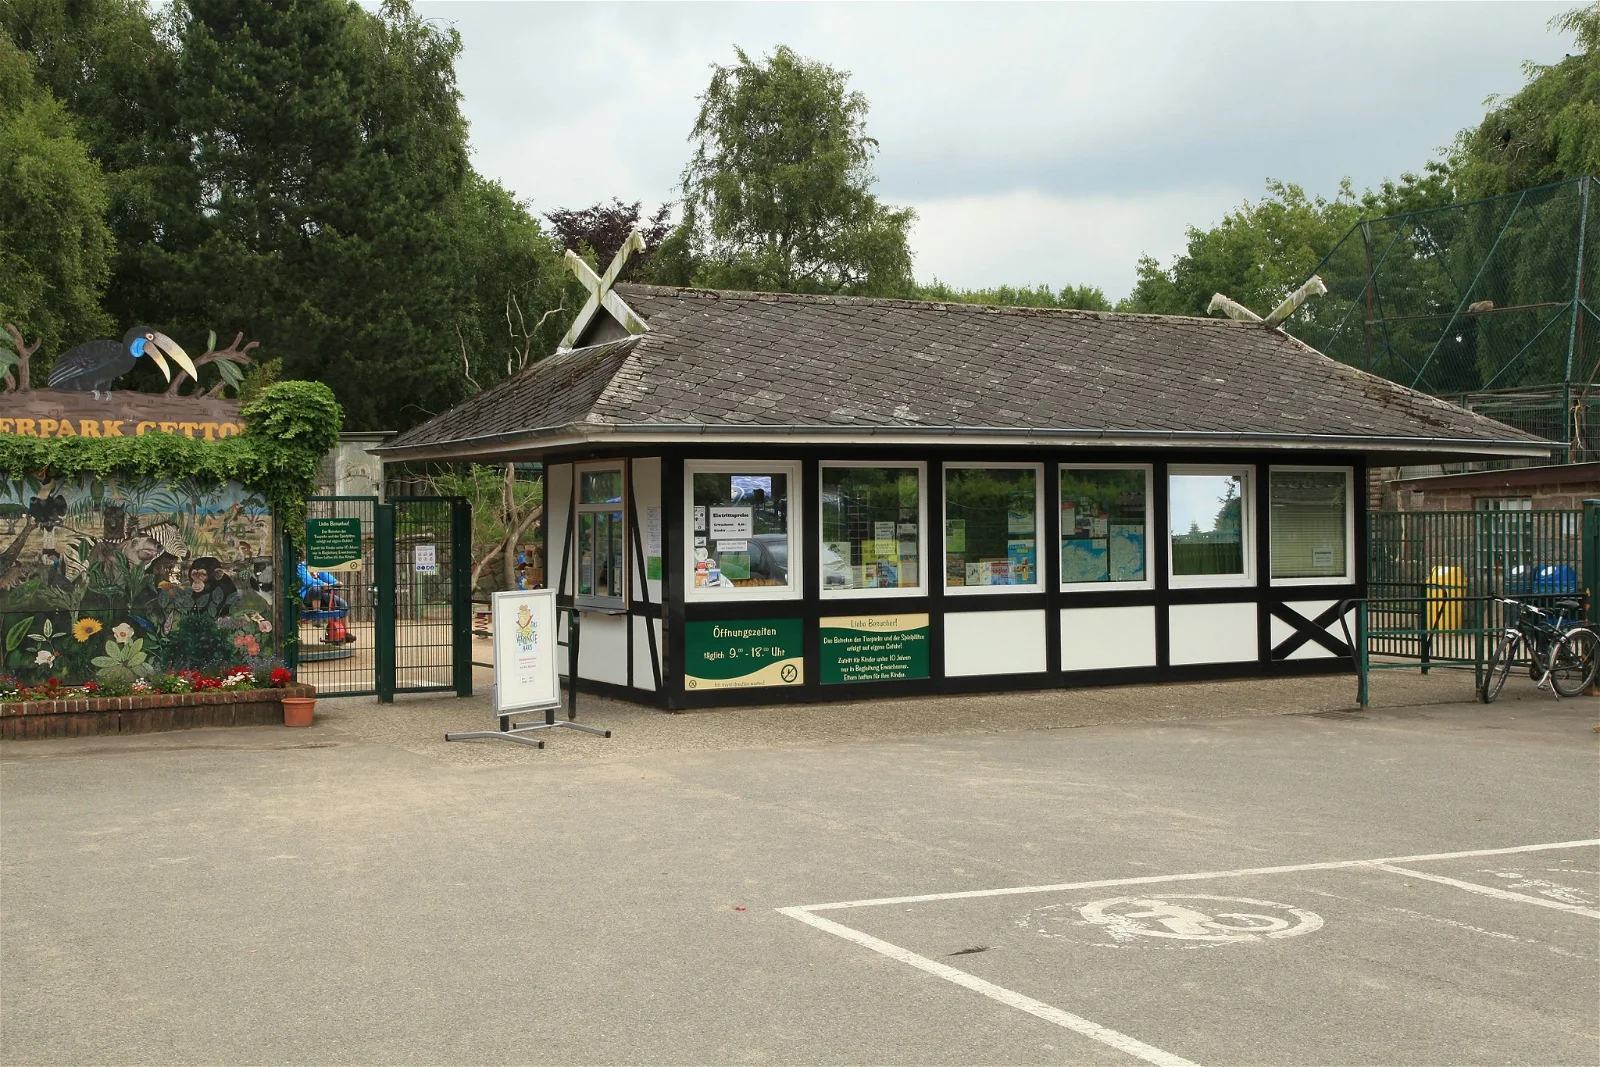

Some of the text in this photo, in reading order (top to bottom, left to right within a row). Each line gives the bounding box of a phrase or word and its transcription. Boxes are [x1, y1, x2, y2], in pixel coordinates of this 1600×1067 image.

[713, 625, 777, 638] Öffnungszeiten
[704, 651, 724, 661] täglich
[771, 646, 785, 657] Uhr
